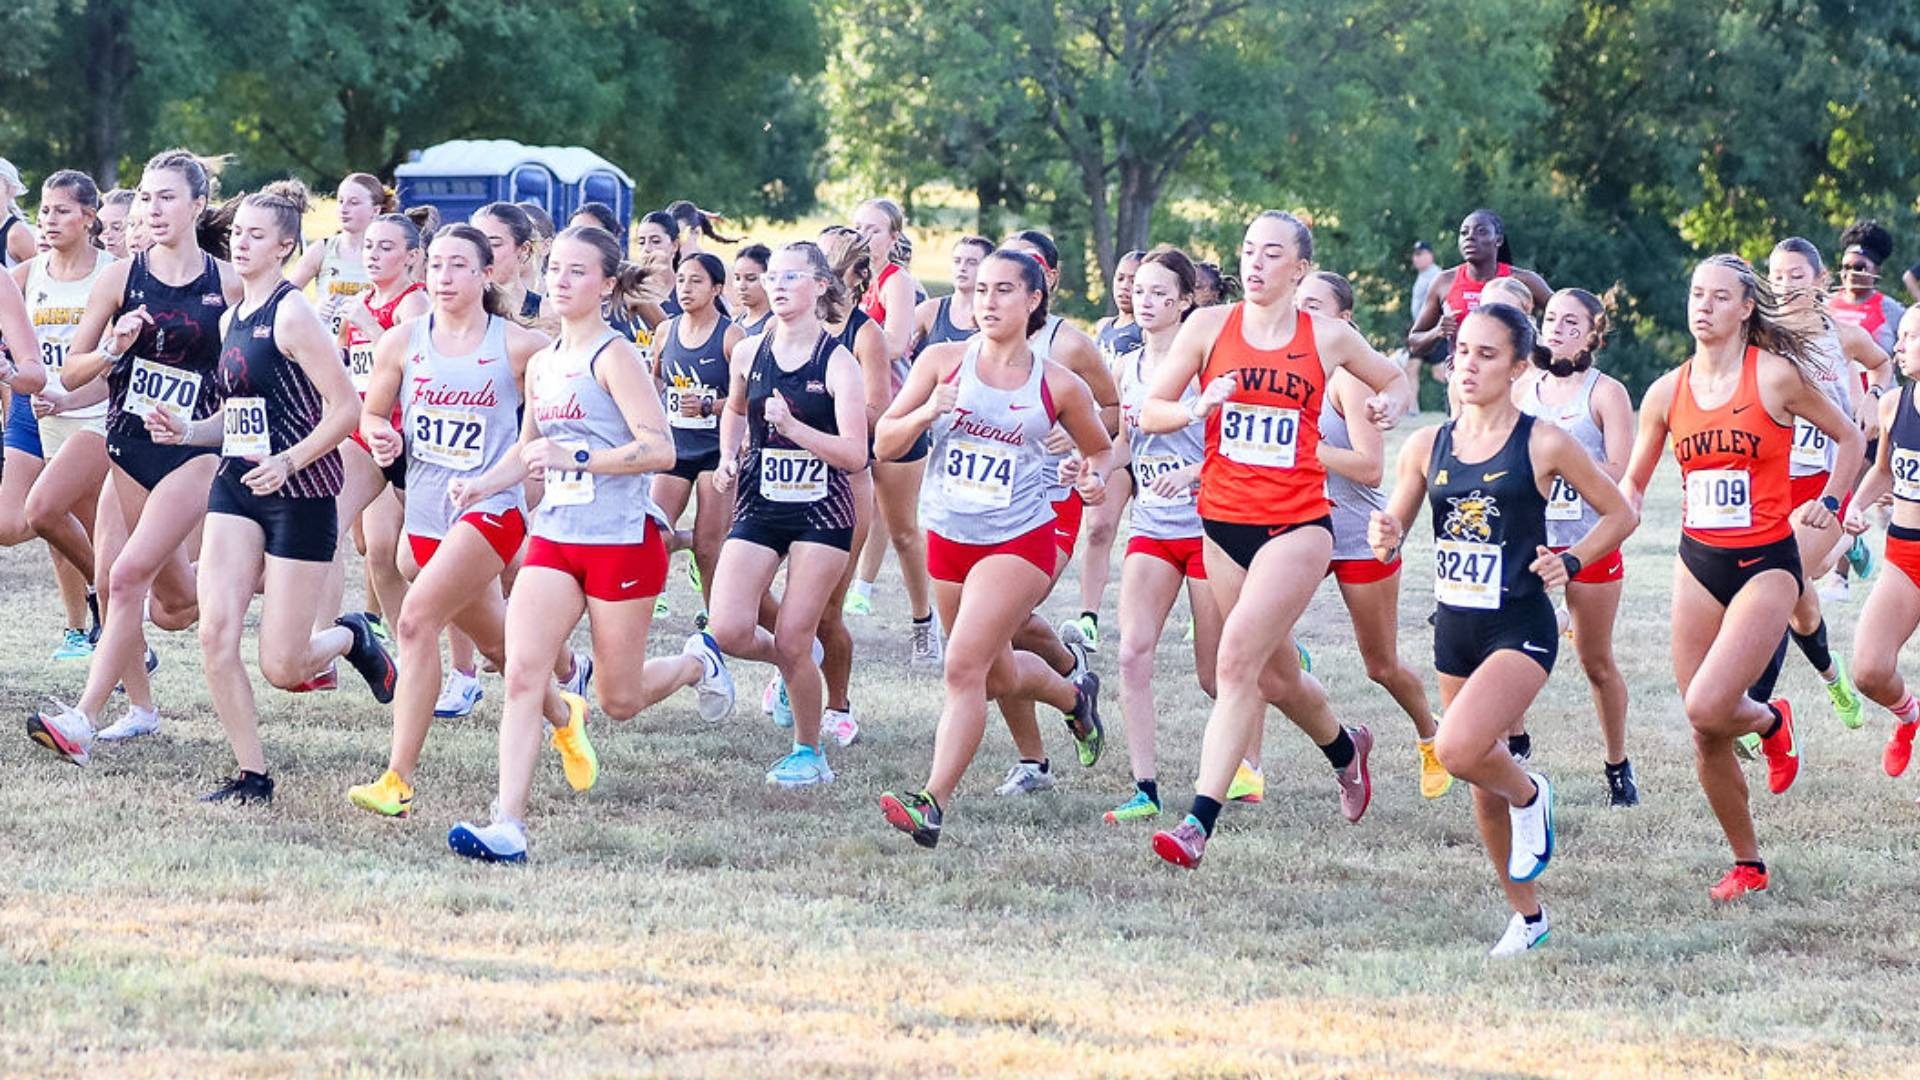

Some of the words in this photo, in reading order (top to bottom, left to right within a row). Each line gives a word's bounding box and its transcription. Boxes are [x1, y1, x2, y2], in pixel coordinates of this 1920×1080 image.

[132, 367, 196, 407] 3070
[411, 377, 498, 407] Friends
[1218, 367, 1316, 409] WLEY
[416, 415, 482, 450] 3172
[949, 408, 1025, 446] Friends
[1224, 411, 1294, 446] 3110
[765, 457, 825, 482] 3072
[947, 449, 1011, 485] 3174
[1895, 457, 1920, 482] 32
[1436, 550, 1497, 585] 3247
